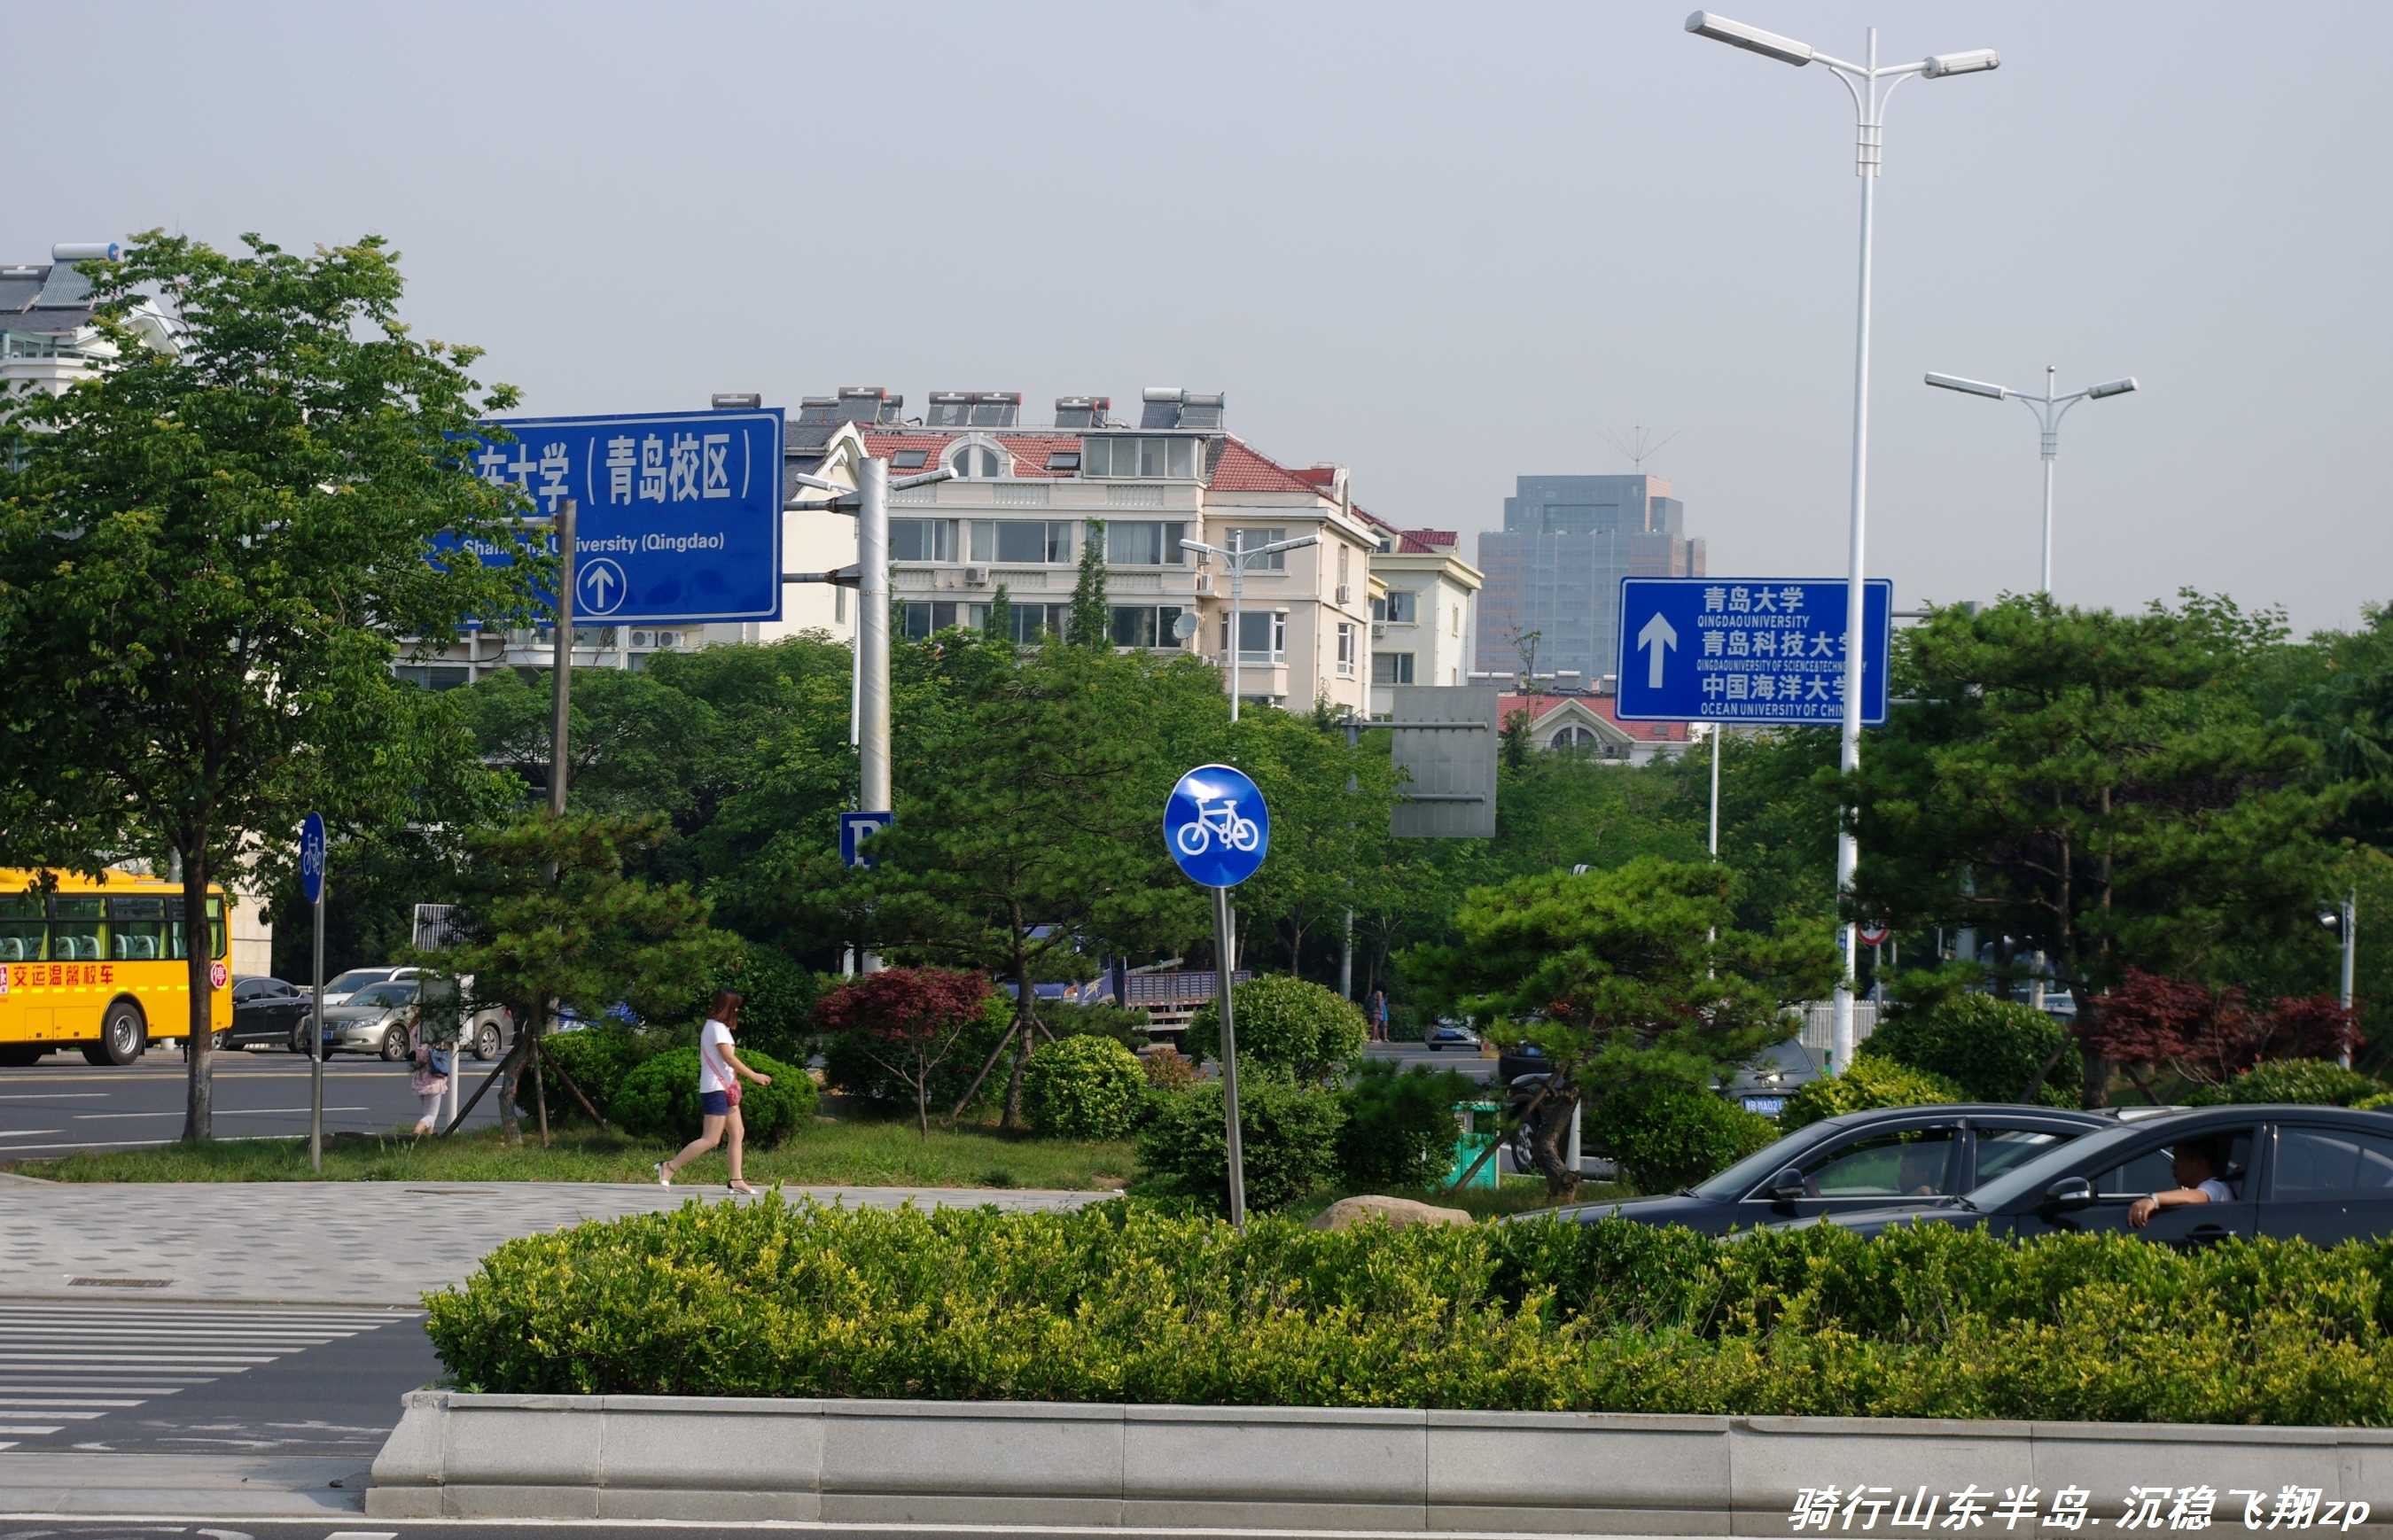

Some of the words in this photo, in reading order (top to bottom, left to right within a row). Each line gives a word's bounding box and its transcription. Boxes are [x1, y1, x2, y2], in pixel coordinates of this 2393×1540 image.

[550, 536, 637, 554] Uiversity
[641, 532, 725, 554] (Qingdao)
[1703, 586, 1804, 614] 青岛大学
[1772, 660, 1782, 673] OF
[1700, 702, 1738, 715] OCEAN
[1740, 704, 1802, 716] UNIVERSITY
[1803, 704, 1818, 716] OF
[1820, 704, 1845, 717] CHIN
[13, 965, 113, 987] 交运温馨校车
[214, 965, 225, 985] 停
